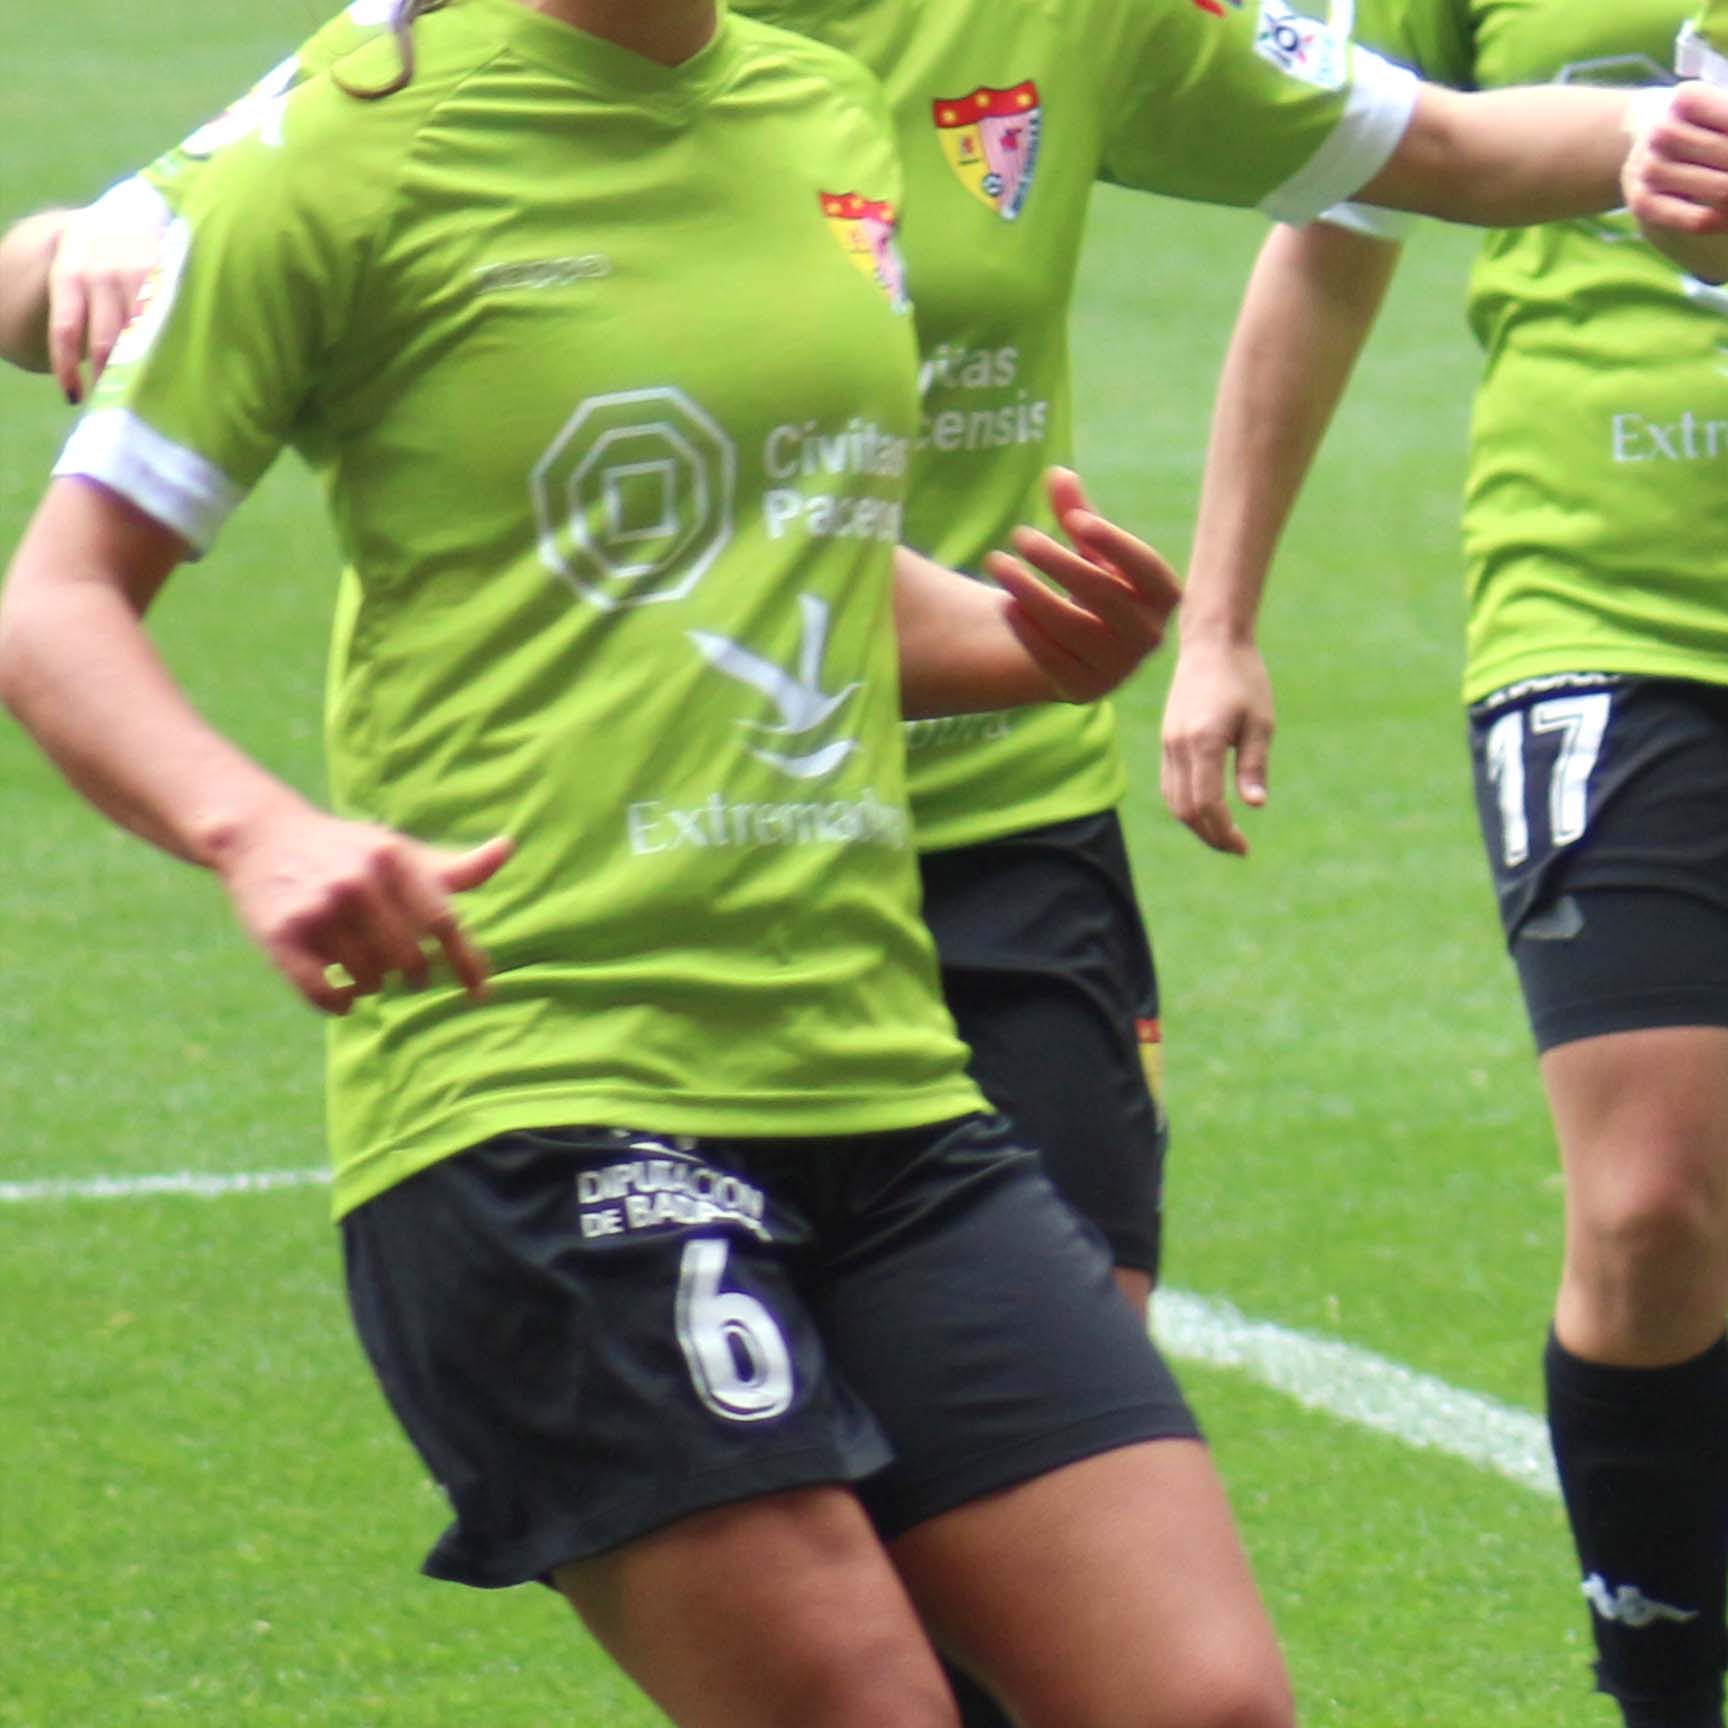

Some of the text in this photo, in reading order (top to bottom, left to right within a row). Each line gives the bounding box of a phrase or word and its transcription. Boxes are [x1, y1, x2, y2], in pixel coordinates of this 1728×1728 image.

[764, 416, 909, 479] Civita
[1486, 692, 1612, 868] 17
[580, 1208, 626, 1239] DE
[674, 1236, 794, 1421] 6
